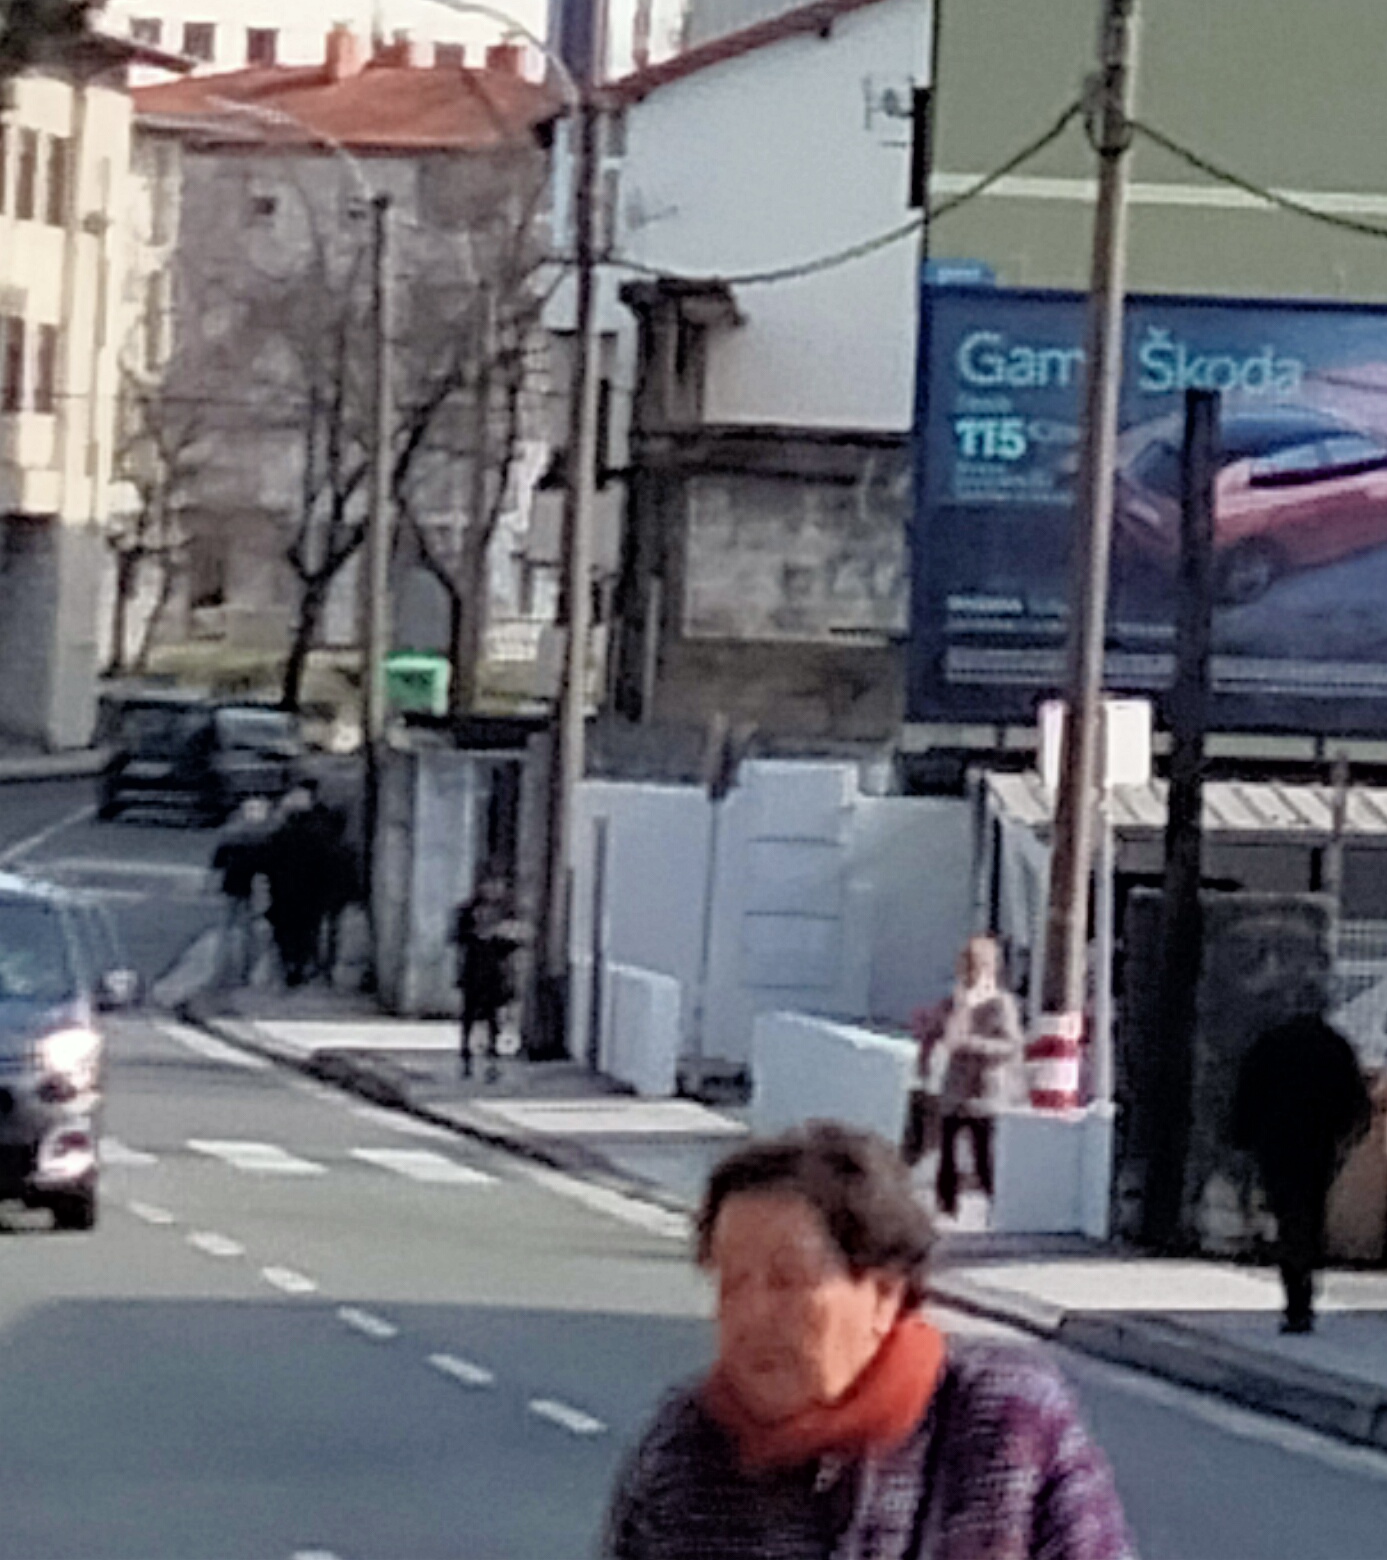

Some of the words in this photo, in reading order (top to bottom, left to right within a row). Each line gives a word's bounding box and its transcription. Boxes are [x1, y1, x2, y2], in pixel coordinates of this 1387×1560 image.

[957, 330, 1087, 387] Gam
[1138, 324, 1304, 394] Škoda
[955, 416, 1027, 462] 115
